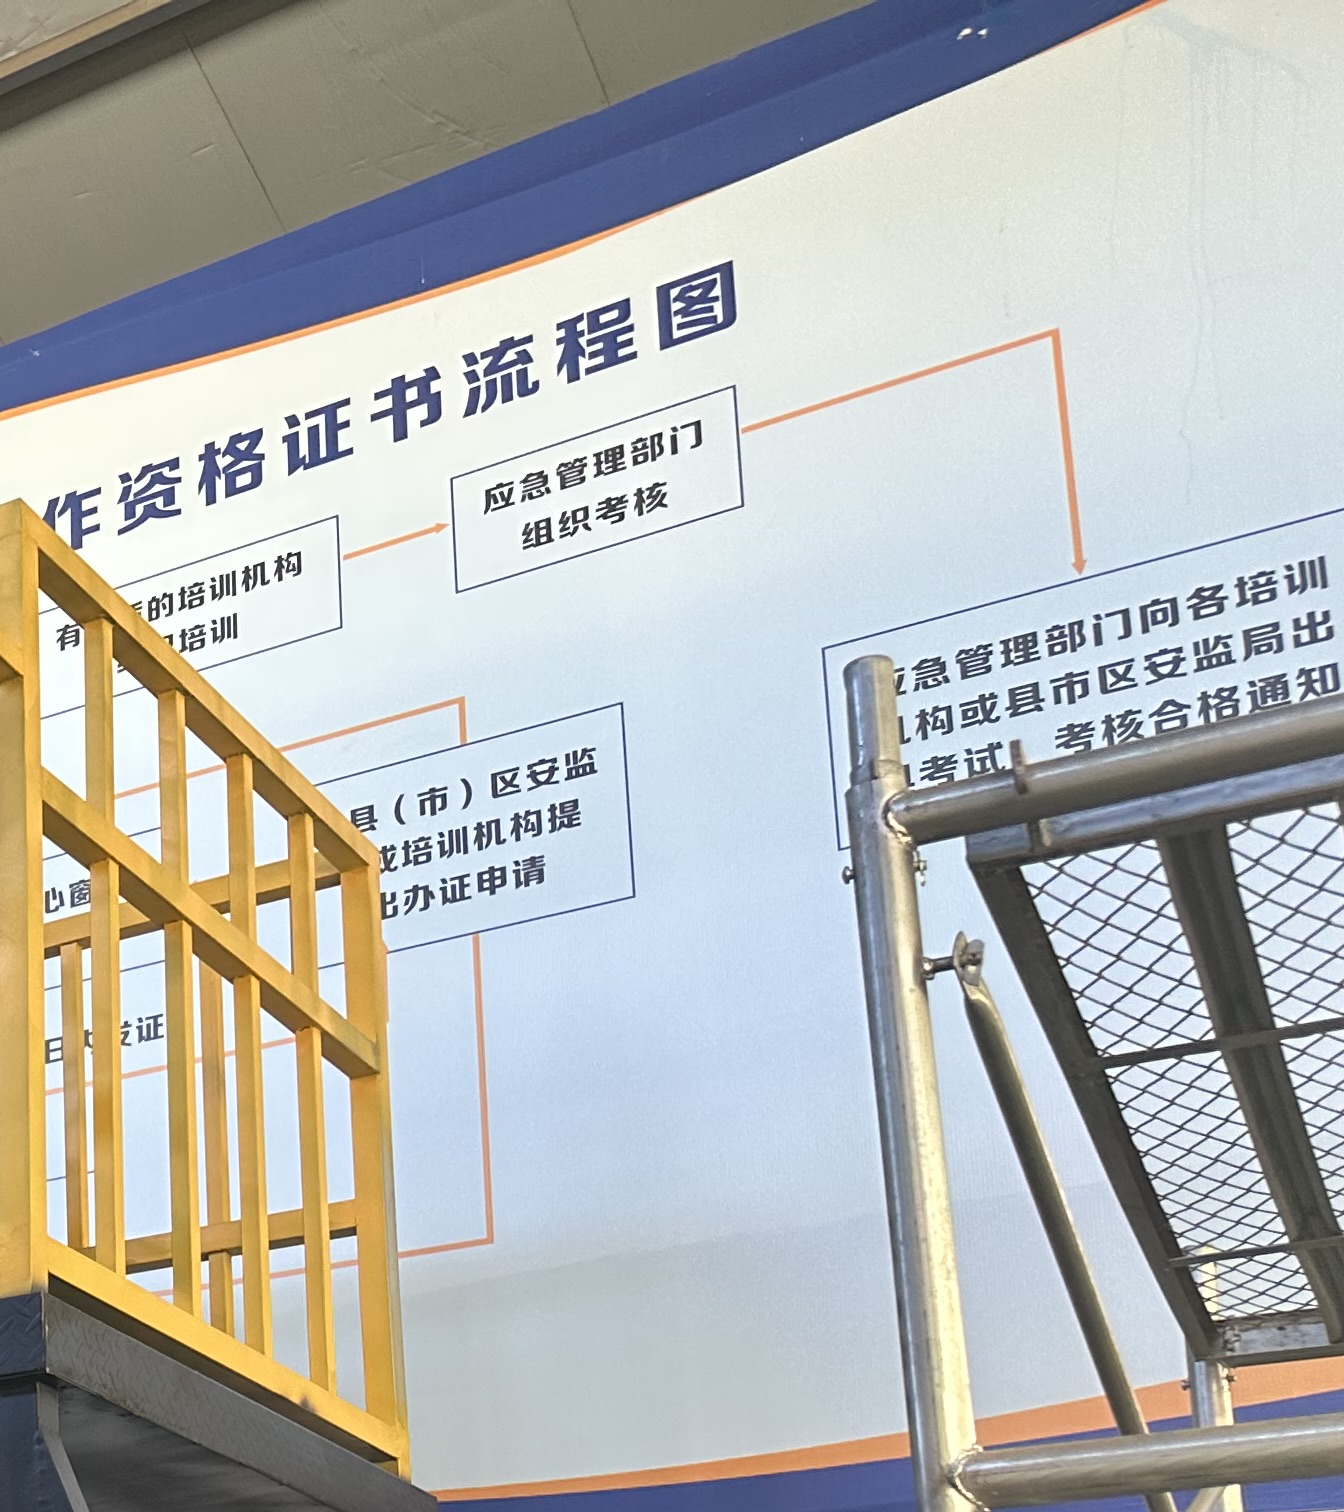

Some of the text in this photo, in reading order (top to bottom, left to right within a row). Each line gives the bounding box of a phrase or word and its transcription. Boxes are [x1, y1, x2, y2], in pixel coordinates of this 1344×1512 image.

[484, 420, 703, 515] 应急管理部门
[522, 482, 668, 550] 组织考核
[56, 551, 302, 651] 有的培训机构
[898, 610, 1334, 745] 构或县市区安监局出
[905, 662, 1341, 786] 考试考核合格通知
[379, 799, 582, 874] 或培训机构提
[381, 855, 545, 920] 出办证申请
